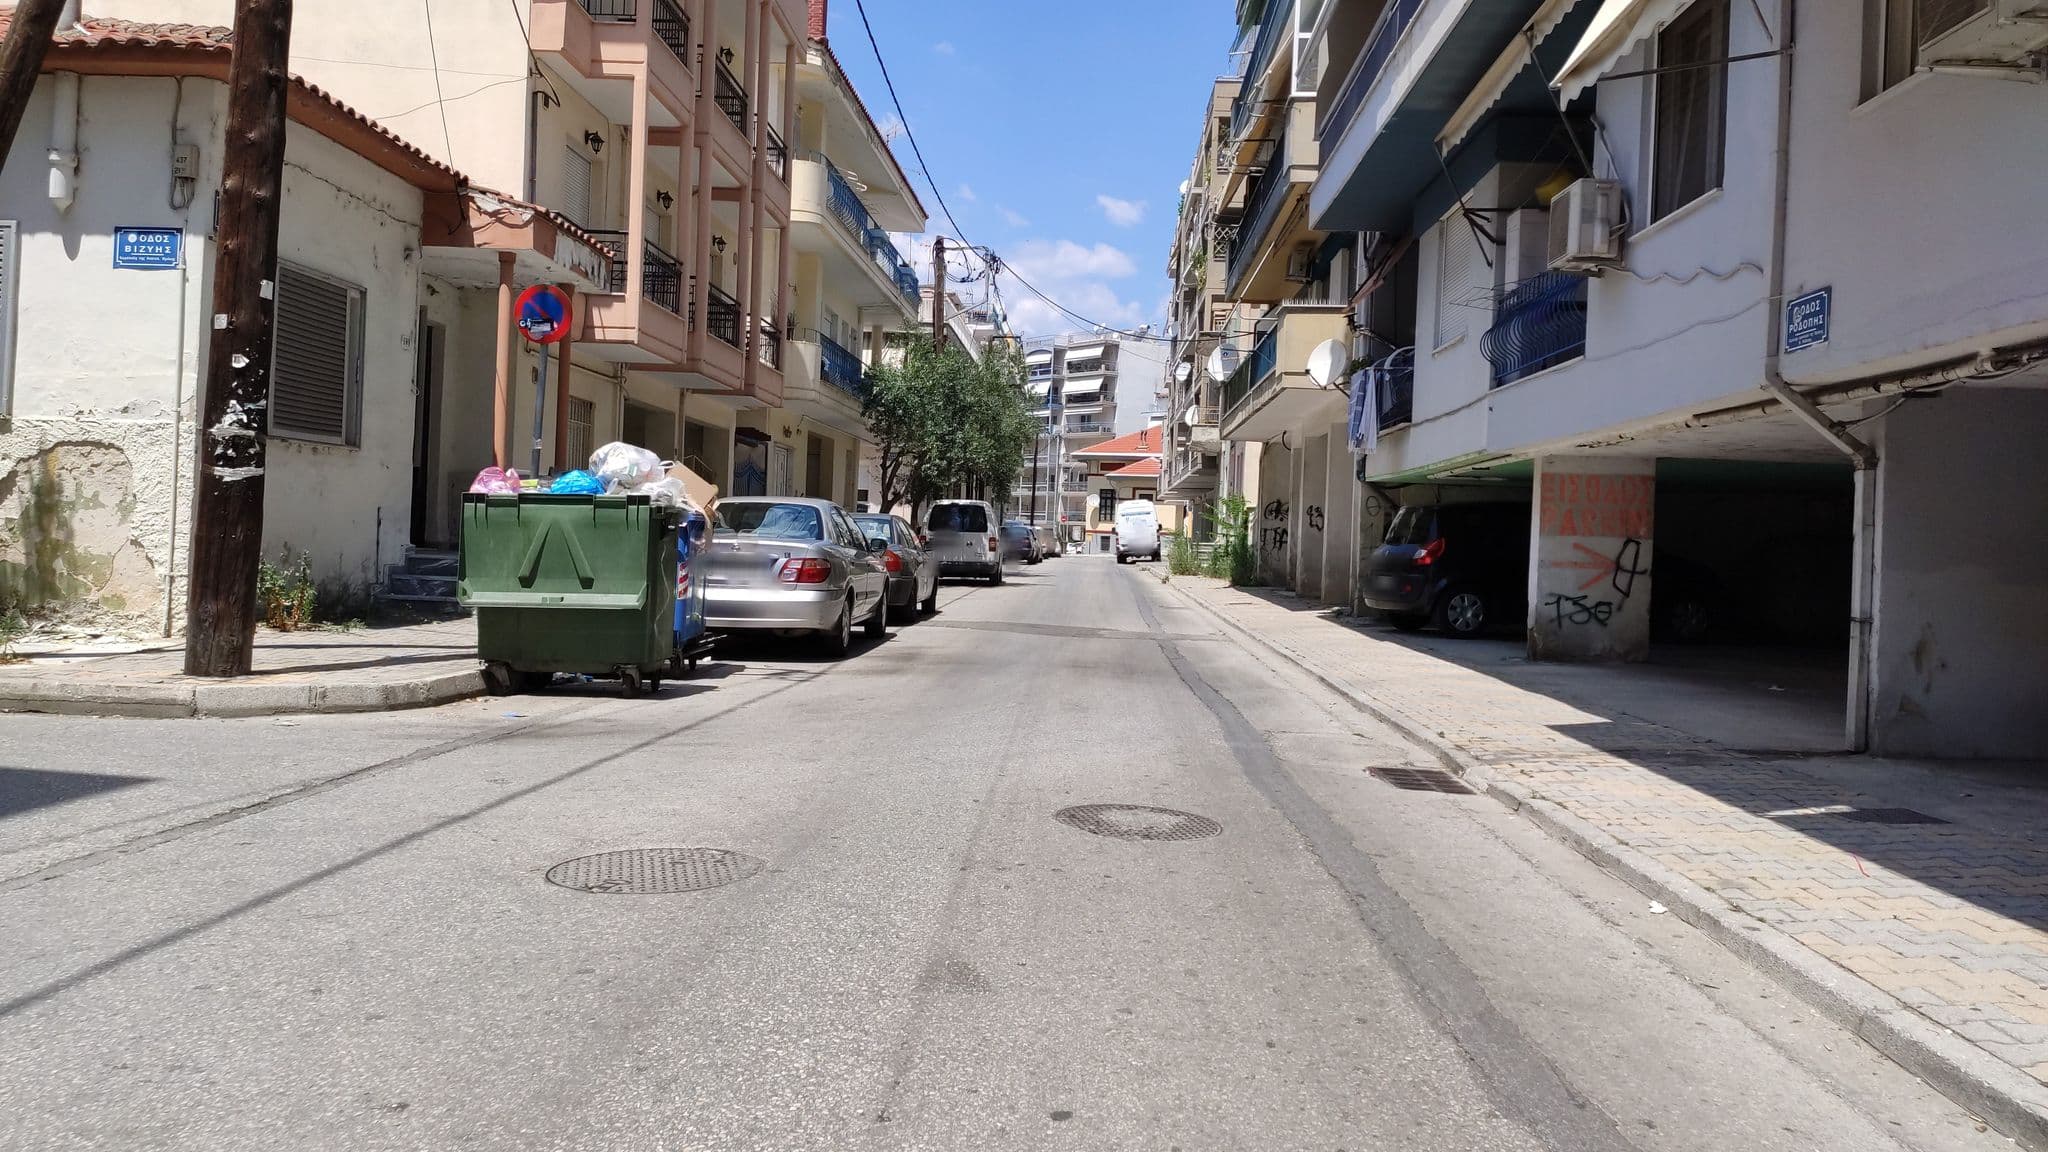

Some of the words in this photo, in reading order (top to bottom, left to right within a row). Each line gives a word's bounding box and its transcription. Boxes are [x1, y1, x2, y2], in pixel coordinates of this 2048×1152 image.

[139, 235, 170, 243] ΟΔΟΣ
[124, 245, 172, 254] ΒΙΖΥΗΣ
[1801, 300, 1820, 315] ΟΔΟΣ
[1789, 315, 1823, 333] ΡΟΔΟΠΗΣ
[1541, 472, 1655, 505] ΕΙΣΟΔΟΣ
